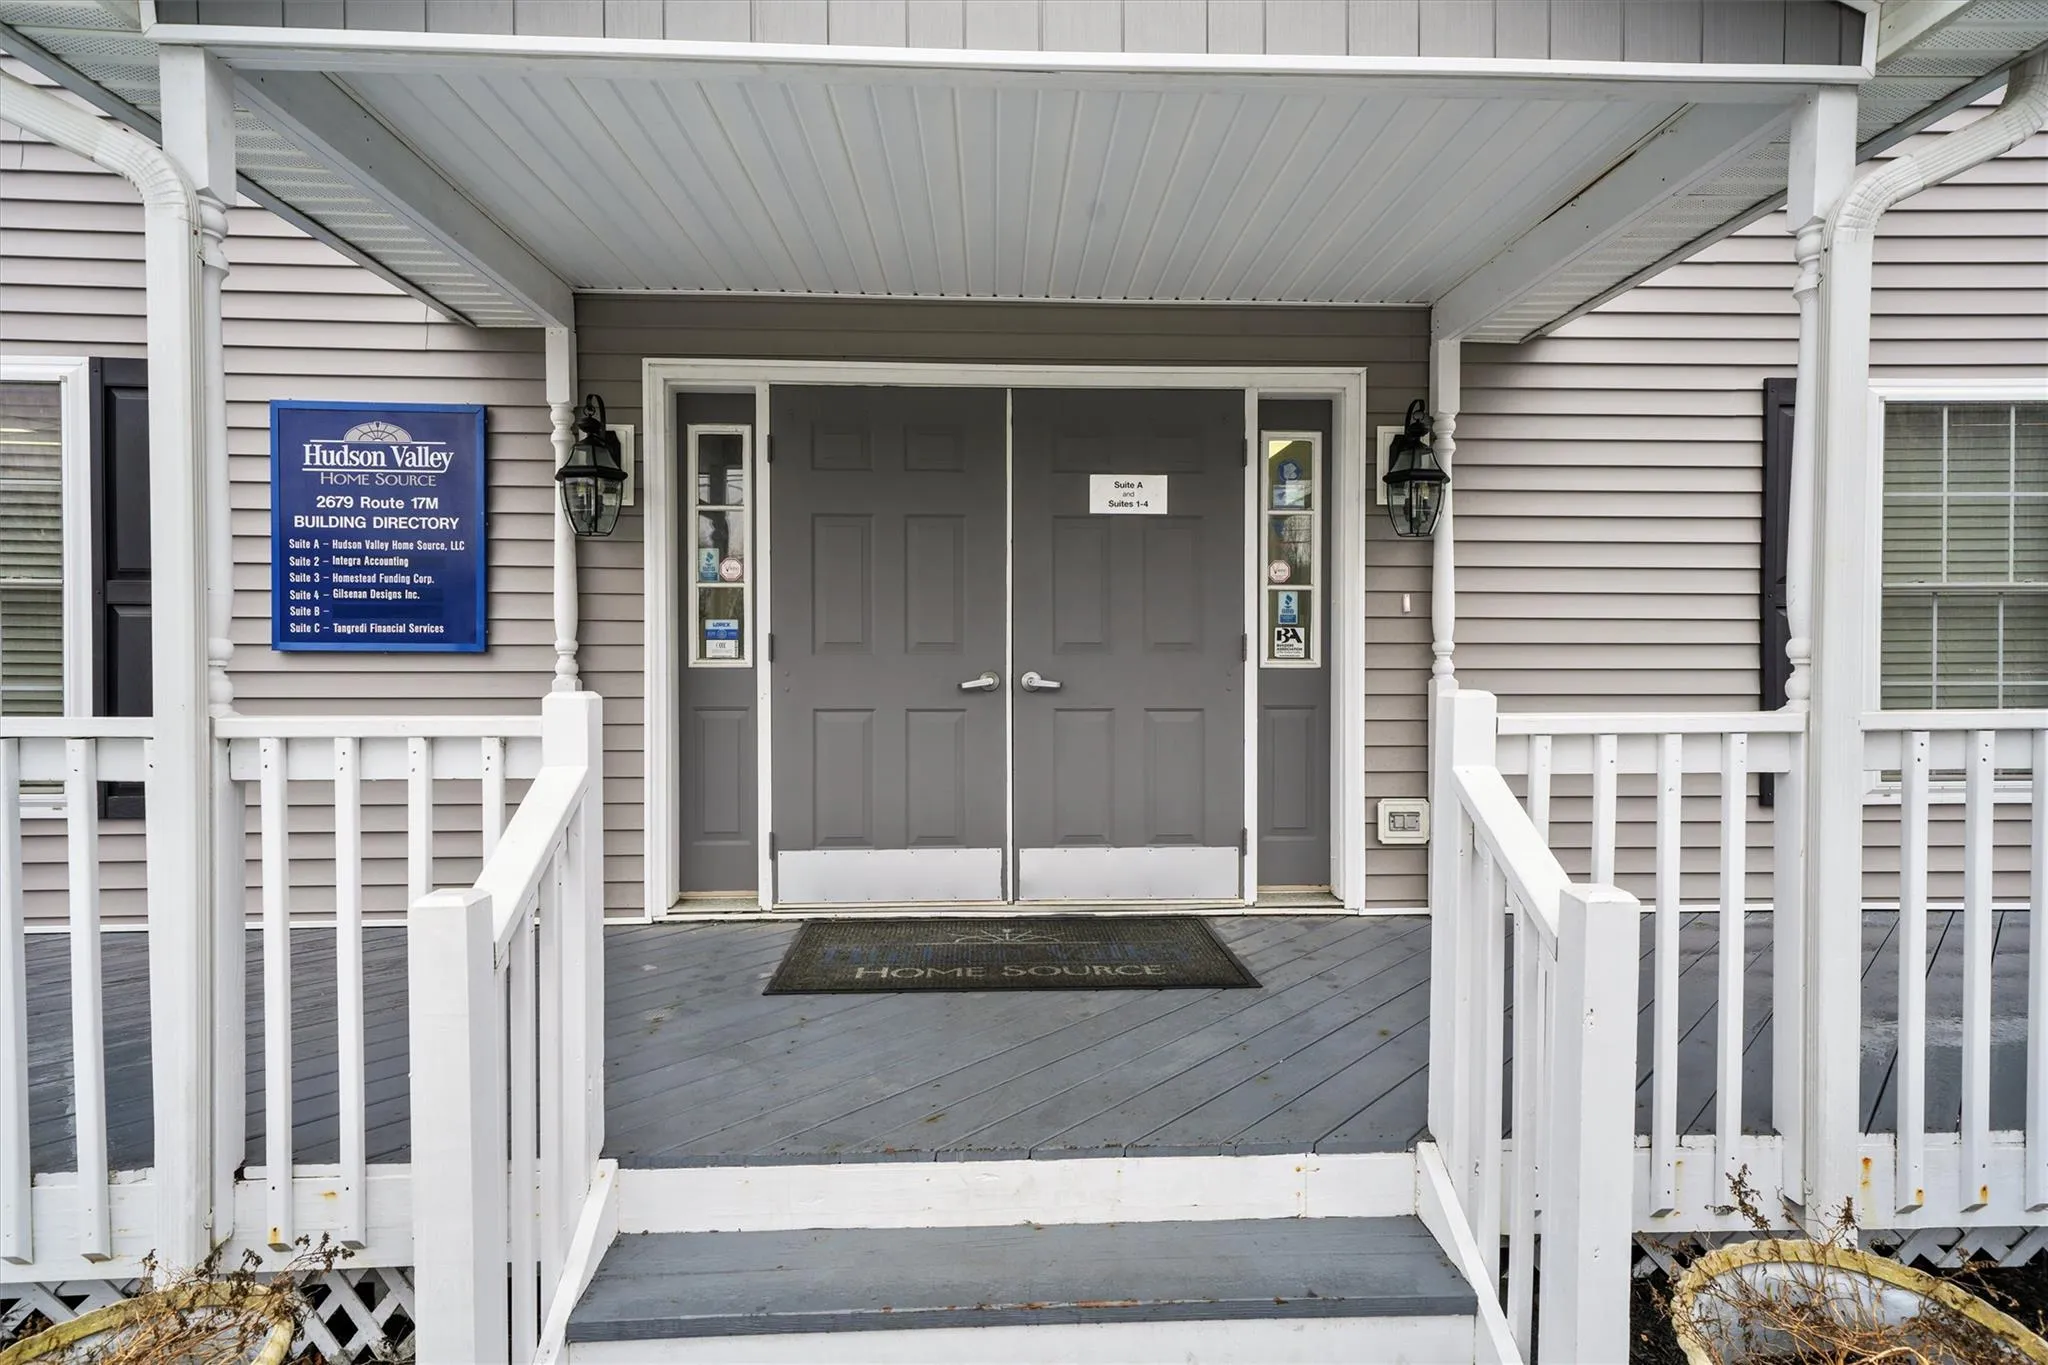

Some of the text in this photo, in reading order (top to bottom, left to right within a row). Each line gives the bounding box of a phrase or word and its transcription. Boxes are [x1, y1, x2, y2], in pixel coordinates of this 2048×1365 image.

[303, 444, 454, 471] Hudson Valley
[320, 472, 437, 487] HOME SOURCE
[1114, 481, 1135, 489] Suite
[316, 495, 439, 510] 2679 Route 17M
[294, 516, 459, 530] BUILDING DIRECTORY
[289, 539, 311, 549] Suite
[313, 539, 320, 549] A
[332, 540, 362, 550] Hudson
[365, 540, 389, 551] Valley
[392, 540, 414, 550] Home
[417, 540, 448, 552] Source,
[451, 541, 465, 551] LLC
[289, 557, 311, 566] Suite
[314, 557, 320, 566] 2
[332, 556, 361, 567] Integra
[364, 556, 409, 568] Accounting
[289, 573, 311, 583] Suite
[314, 573, 320, 583] 3
[332, 573, 376, 583] Homestead
[379, 574, 411, 585] Funding
[414, 574, 435, 585] Corp.
[289, 590, 311, 600] Suite
[314, 590, 320, 600] 4
[333, 589, 367, 599] Gilsenan
[370, 590, 402, 600] Designs
[405, 590, 420, 600] Inc.
[290, 607, 312, 616] Suite
[314, 607, 320, 616] B
[290, 623, 312, 633] Suite
[314, 623, 320, 633] C
[333, 623, 367, 634] Tangredi
[370, 623, 406, 633] Financial
[409, 624, 444, 633] Services
[855, 964, 1166, 979] HOME SOURCE
